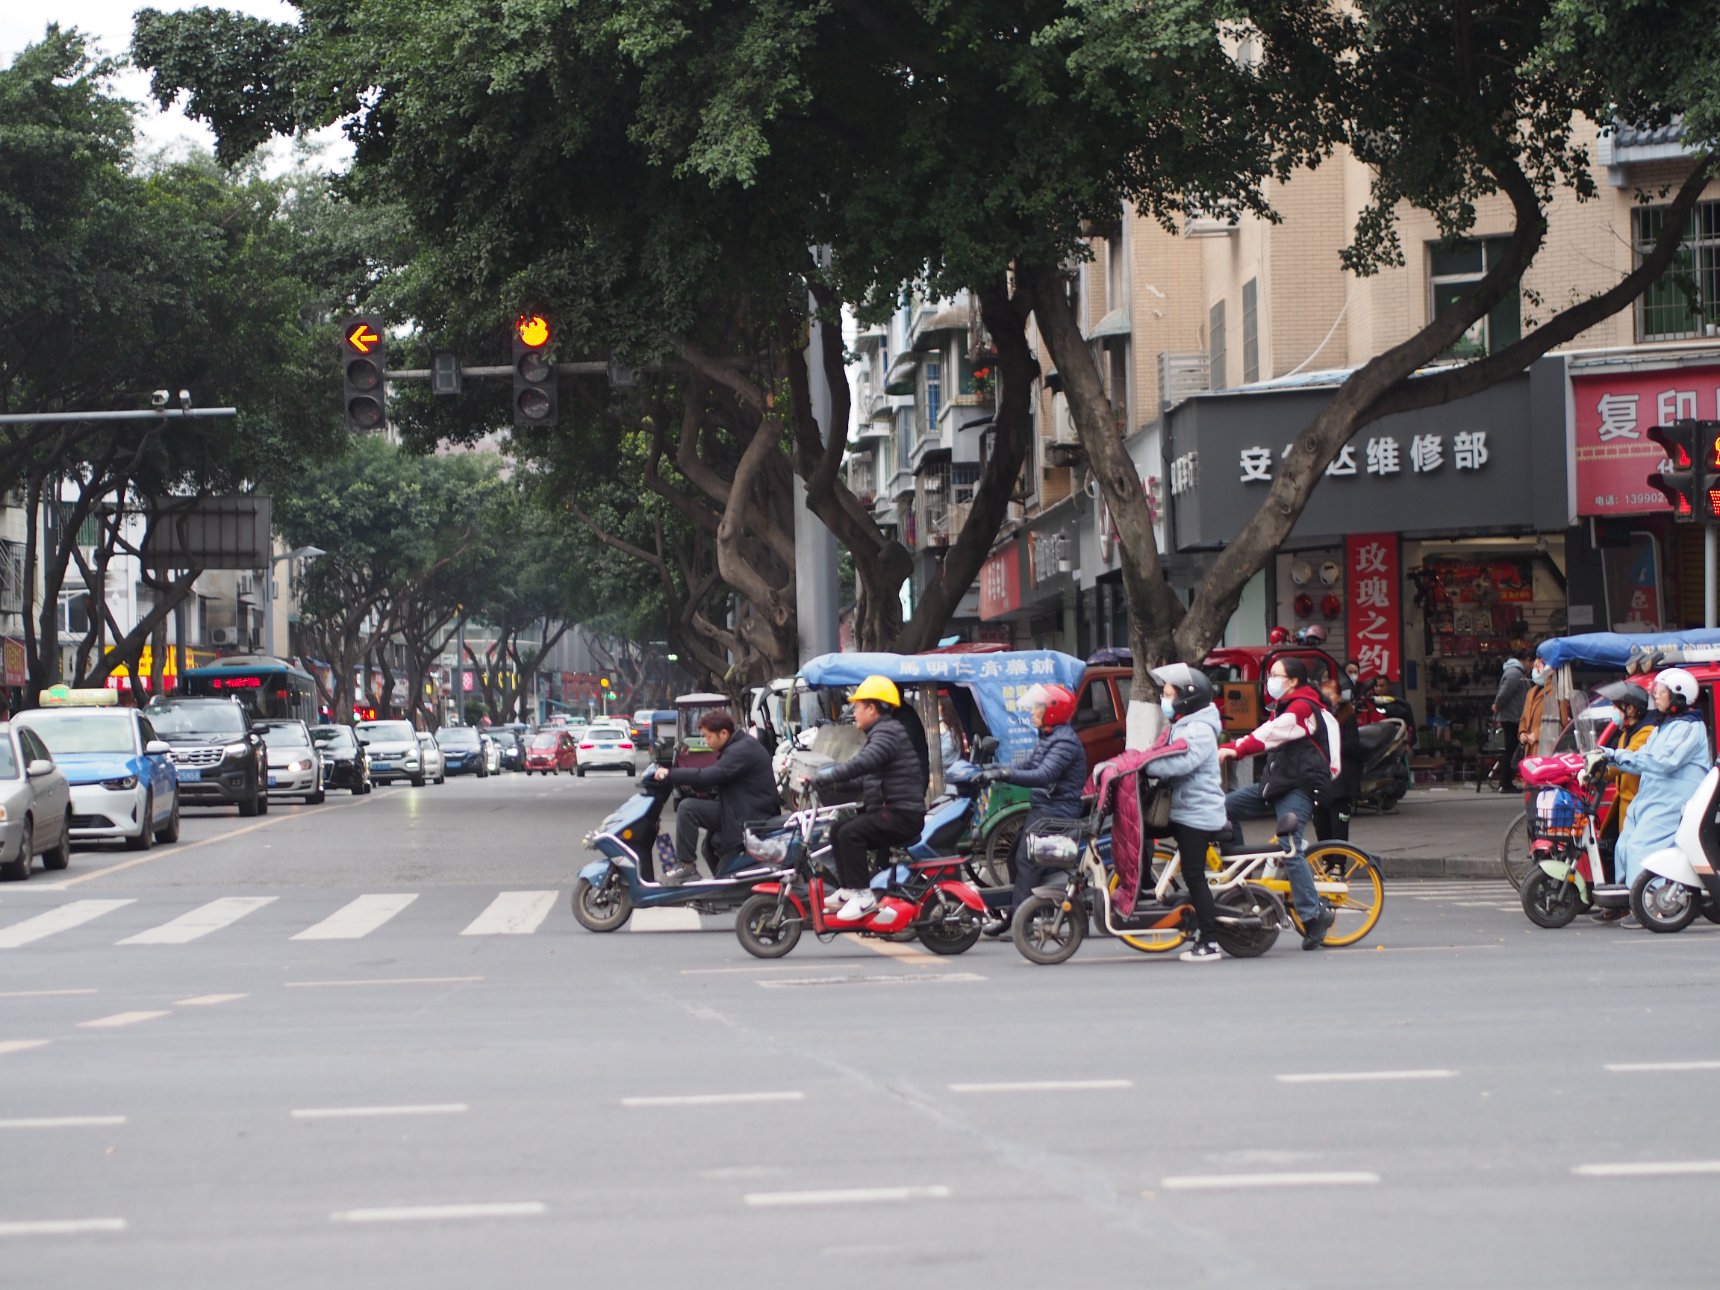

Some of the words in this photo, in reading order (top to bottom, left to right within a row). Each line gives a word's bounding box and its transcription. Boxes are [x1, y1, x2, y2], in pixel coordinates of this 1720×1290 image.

[1597, 380, 1720, 441] 复印
[1239, 431, 1489, 482] 安达维修部
[1625, 492, 1668, 504] 139902
[1355, 542, 1390, 676] 玫瑰之约
